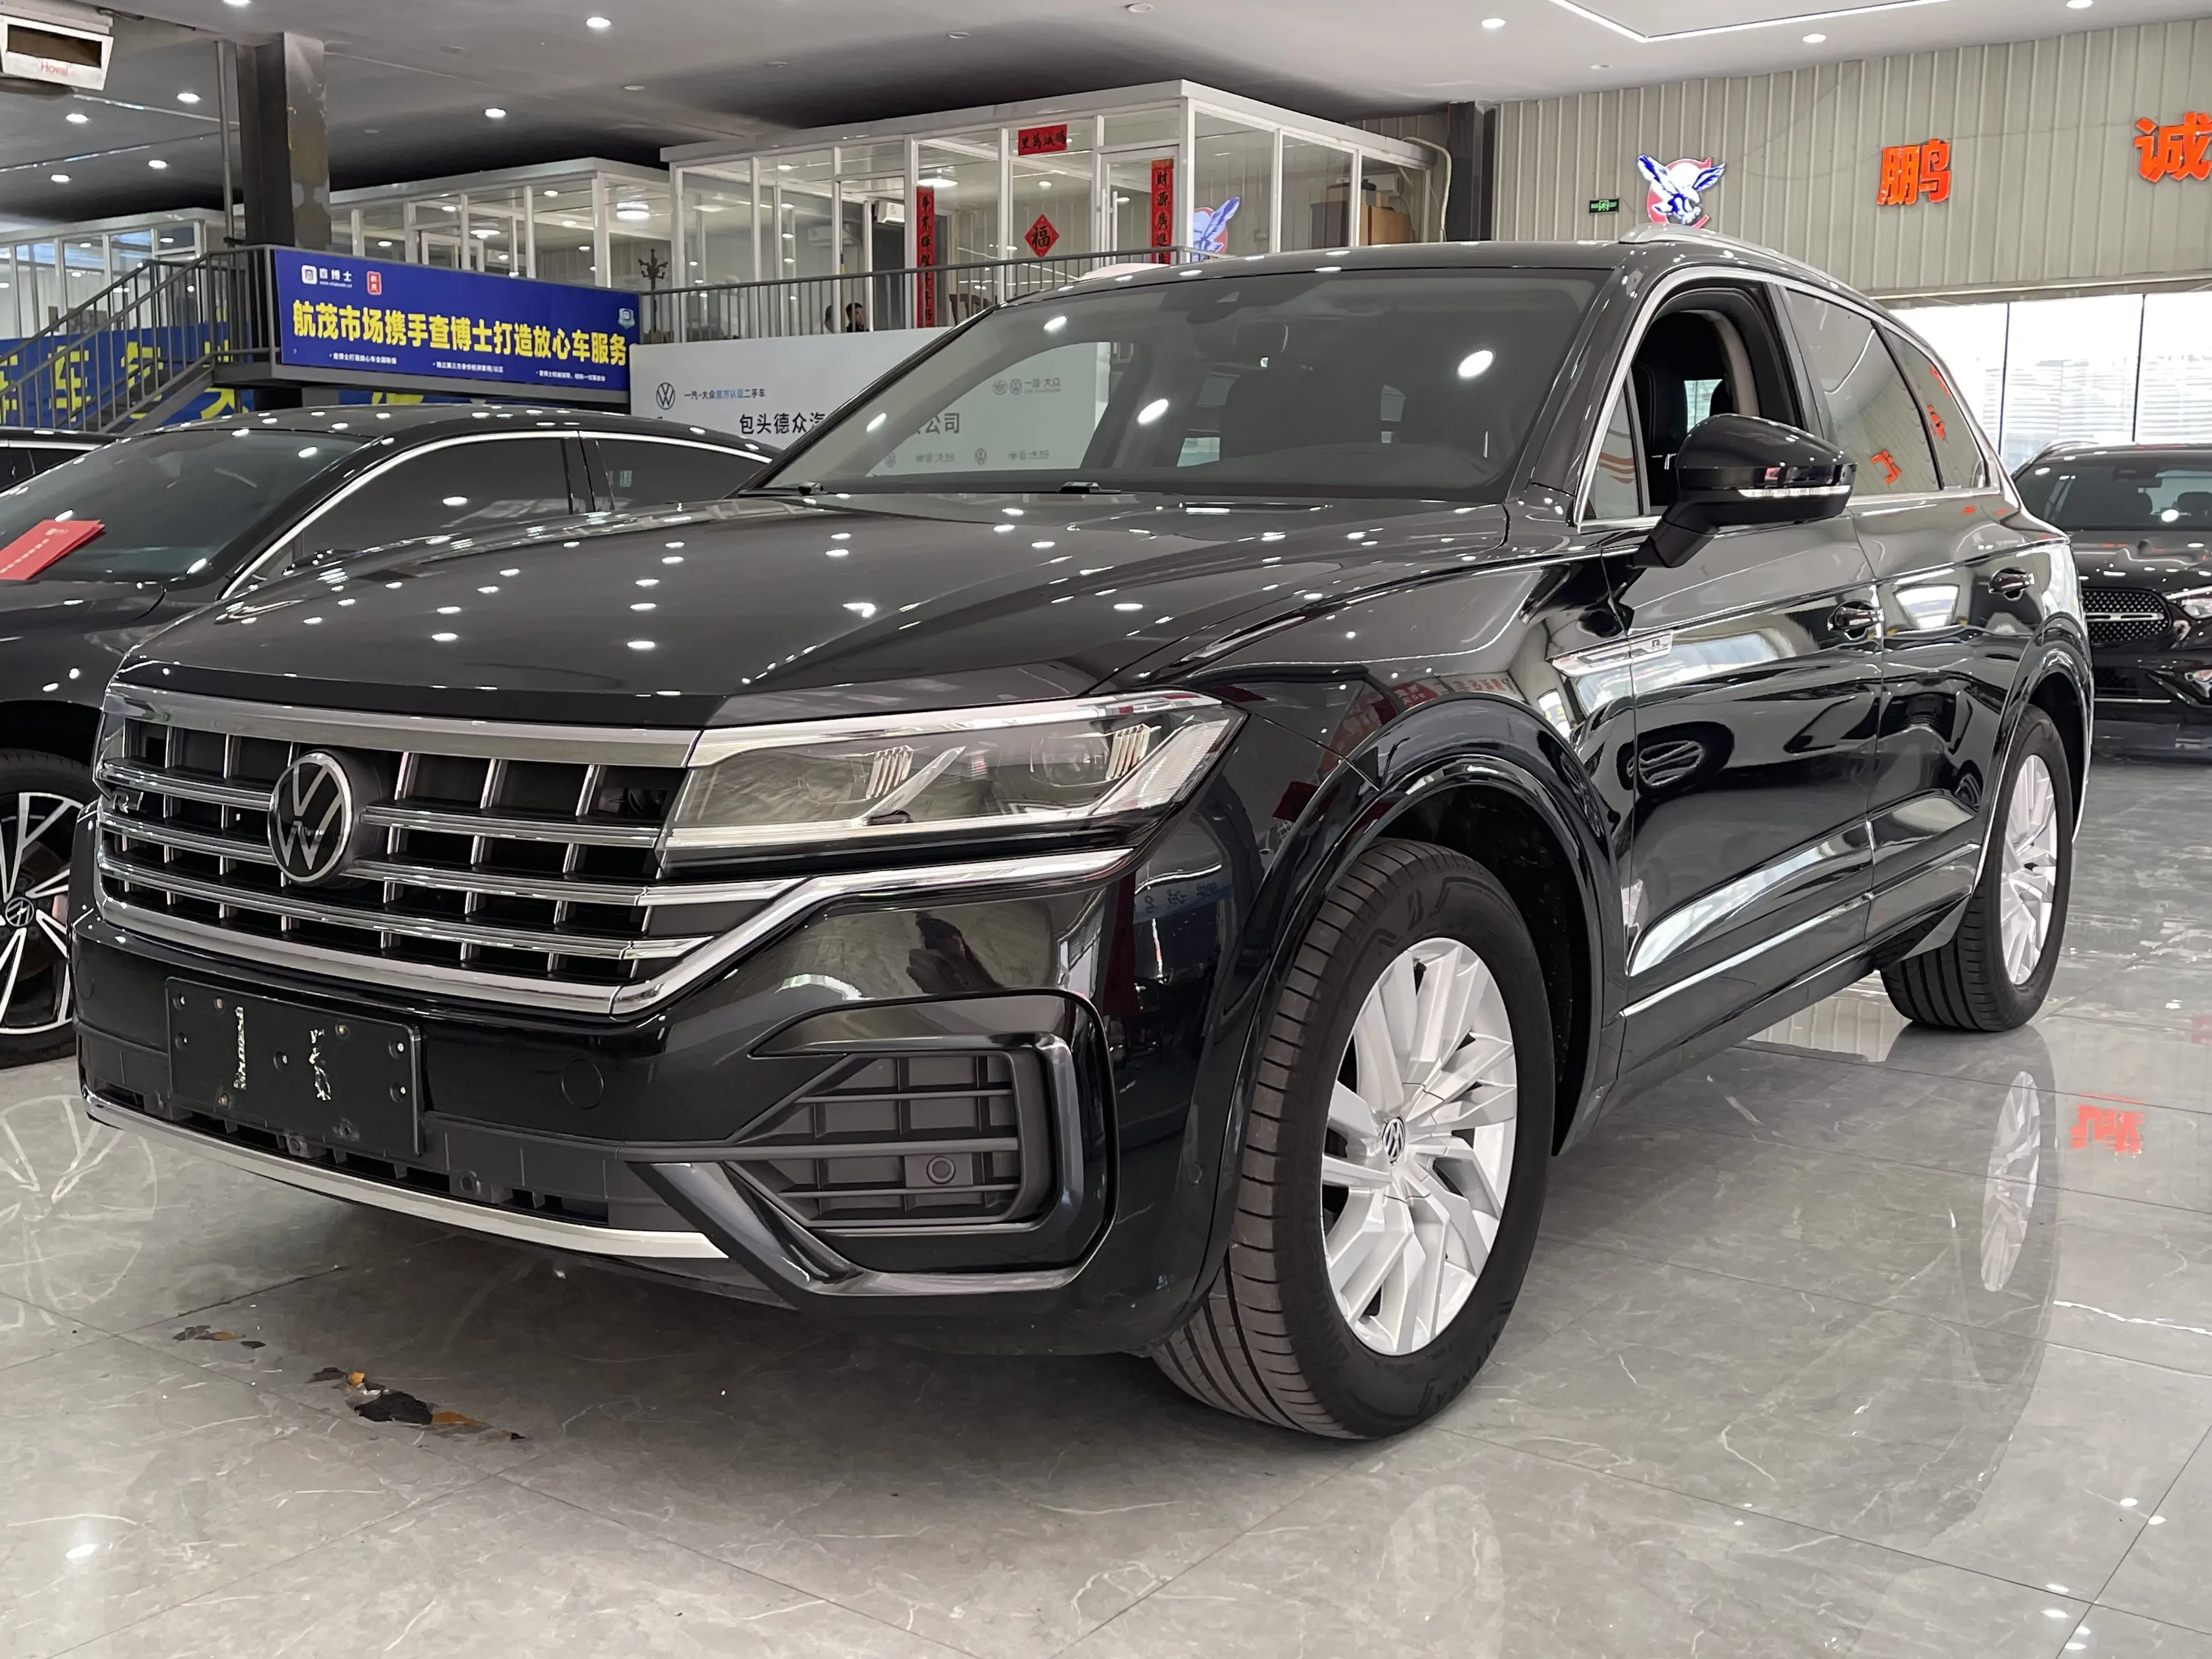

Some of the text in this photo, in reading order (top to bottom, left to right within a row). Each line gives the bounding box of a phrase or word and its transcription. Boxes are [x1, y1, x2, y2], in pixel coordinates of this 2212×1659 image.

[41, 61, 68, 76] Hoval
[1877, 111, 2212, 205] 鹏 诚
[1031, 225, 1050, 249] 福
[292, 299, 627, 366] 航茂市场携手查博士打造放心车服务
[917, 413, 960, 435] 公司
